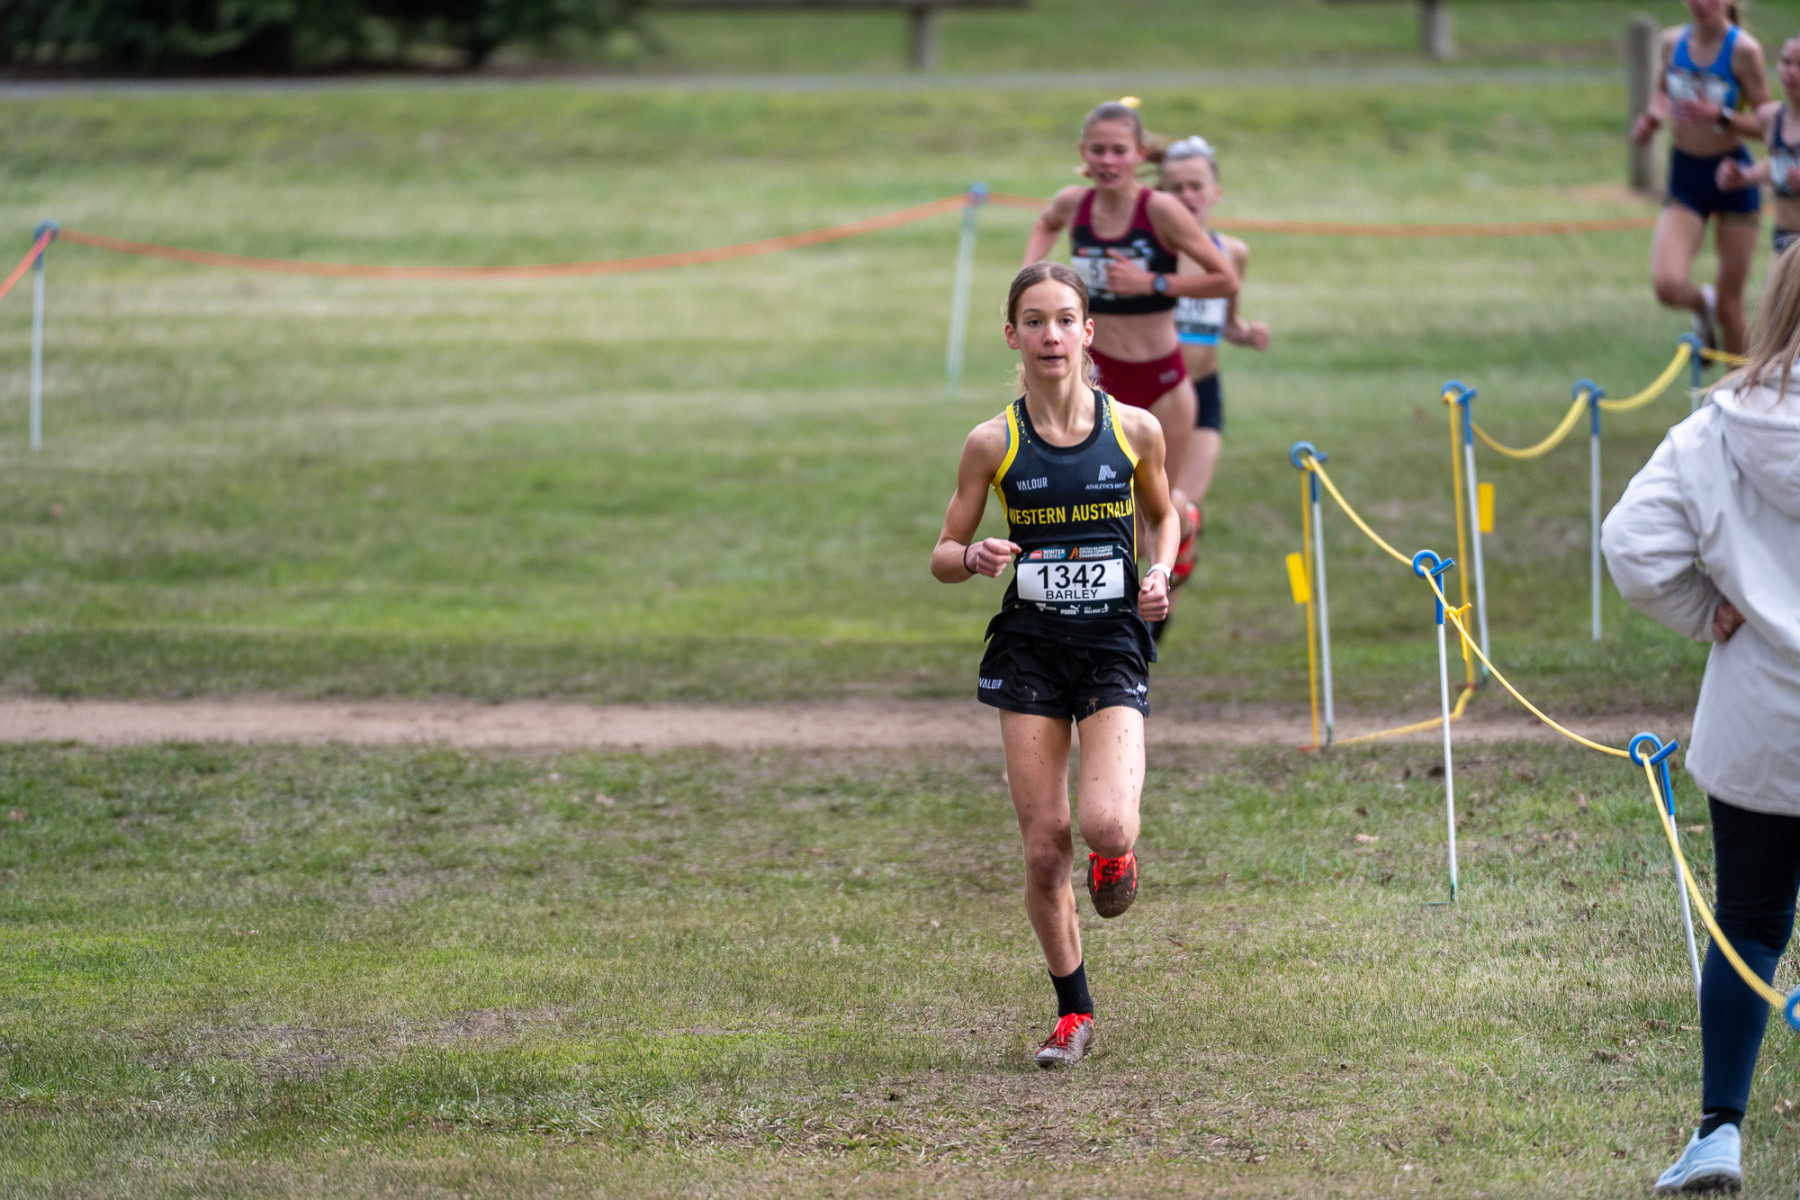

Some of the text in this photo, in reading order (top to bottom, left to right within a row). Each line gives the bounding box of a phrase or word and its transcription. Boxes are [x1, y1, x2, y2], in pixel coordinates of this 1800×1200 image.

[1017, 477, 1048, 491] VALOUR
[1009, 506, 1066, 525] WESTERN
[1038, 564, 1106, 589] 1342
[1046, 589, 1098, 600] BARLEY
